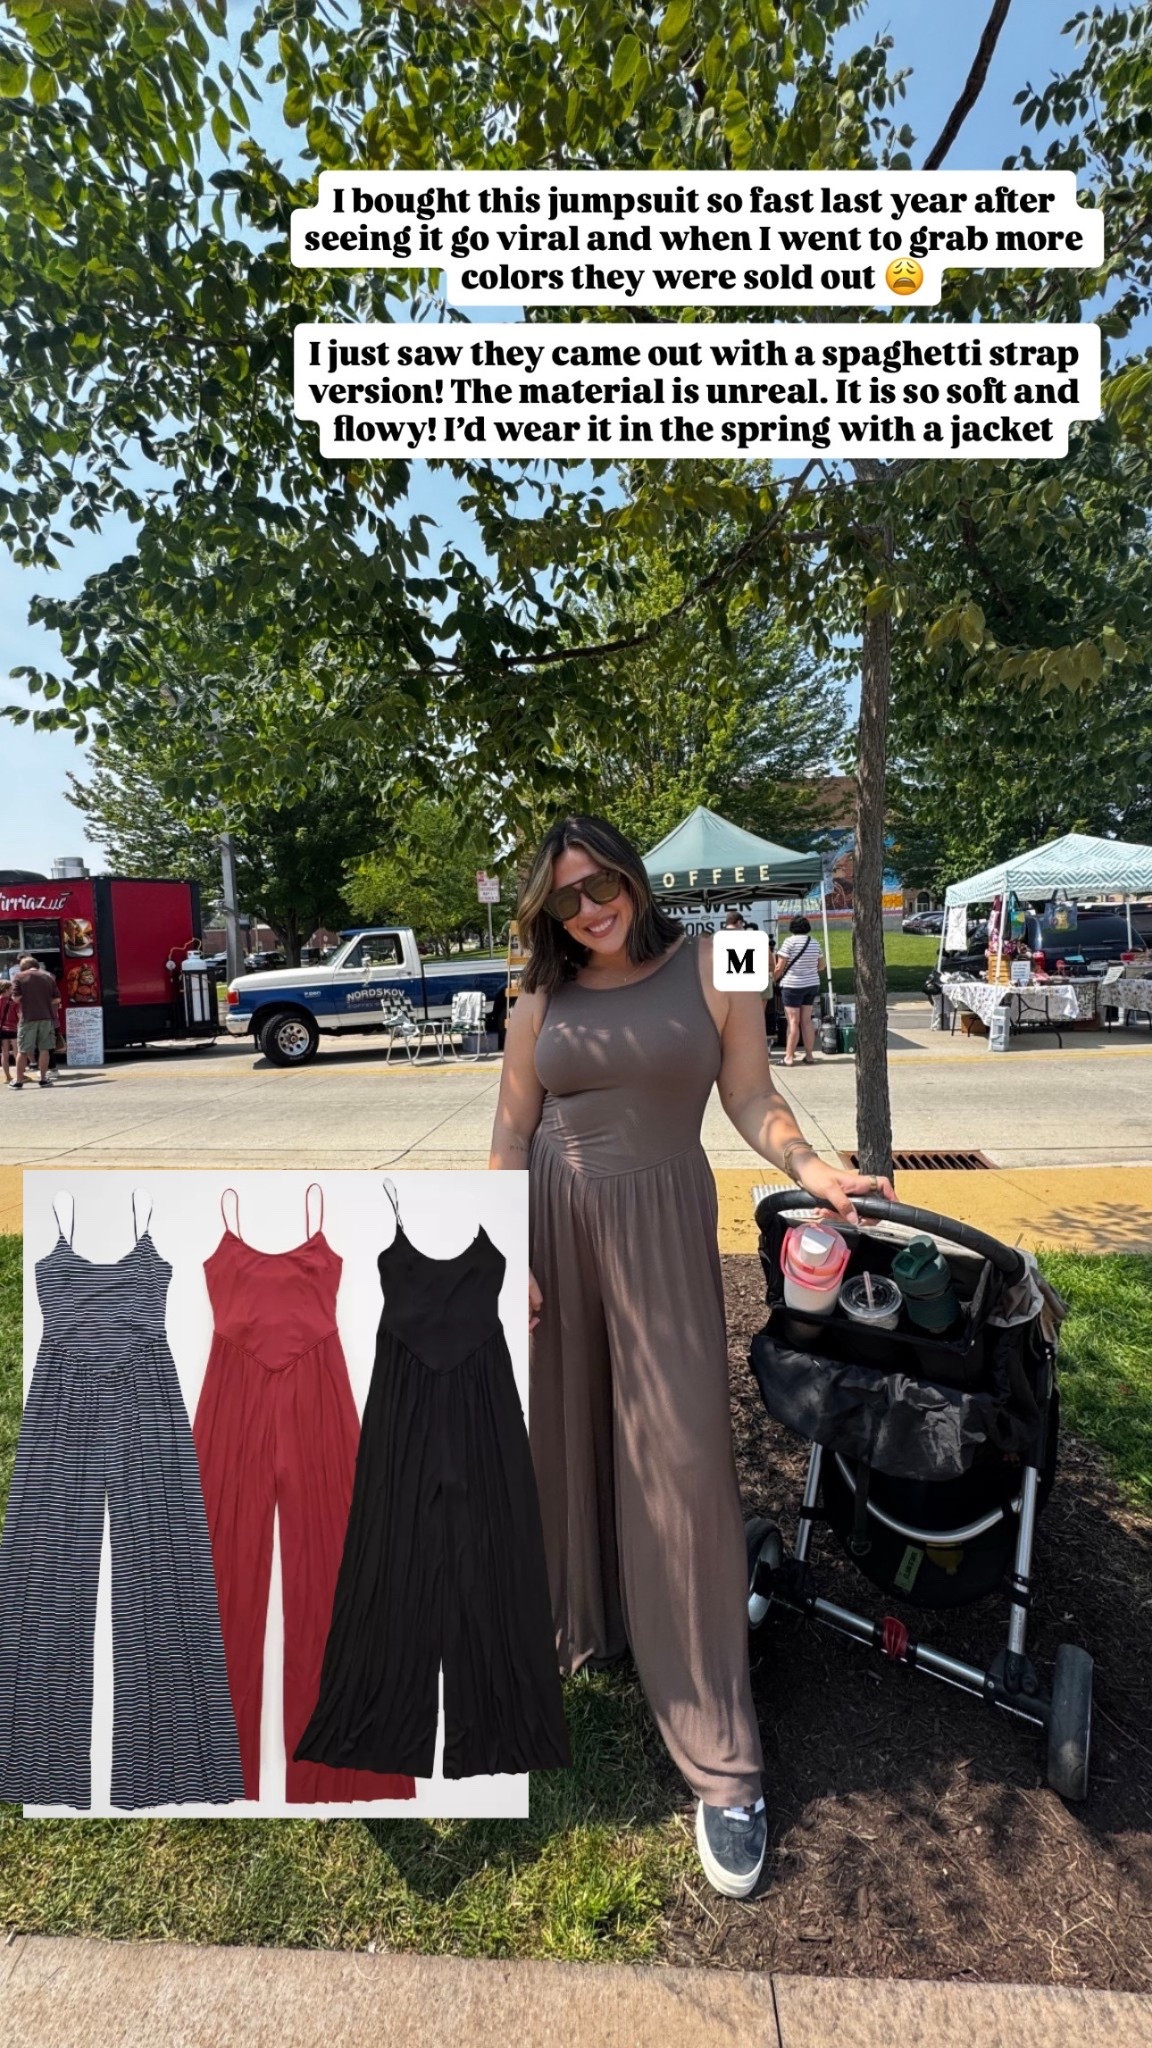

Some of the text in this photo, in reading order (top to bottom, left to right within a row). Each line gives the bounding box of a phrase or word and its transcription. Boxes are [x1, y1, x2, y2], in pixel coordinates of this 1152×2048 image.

[662, 864, 770, 888] OFFEE
[684, 921, 715, 937] ODS
[346, 987, 406, 1002] NORDSKOV
